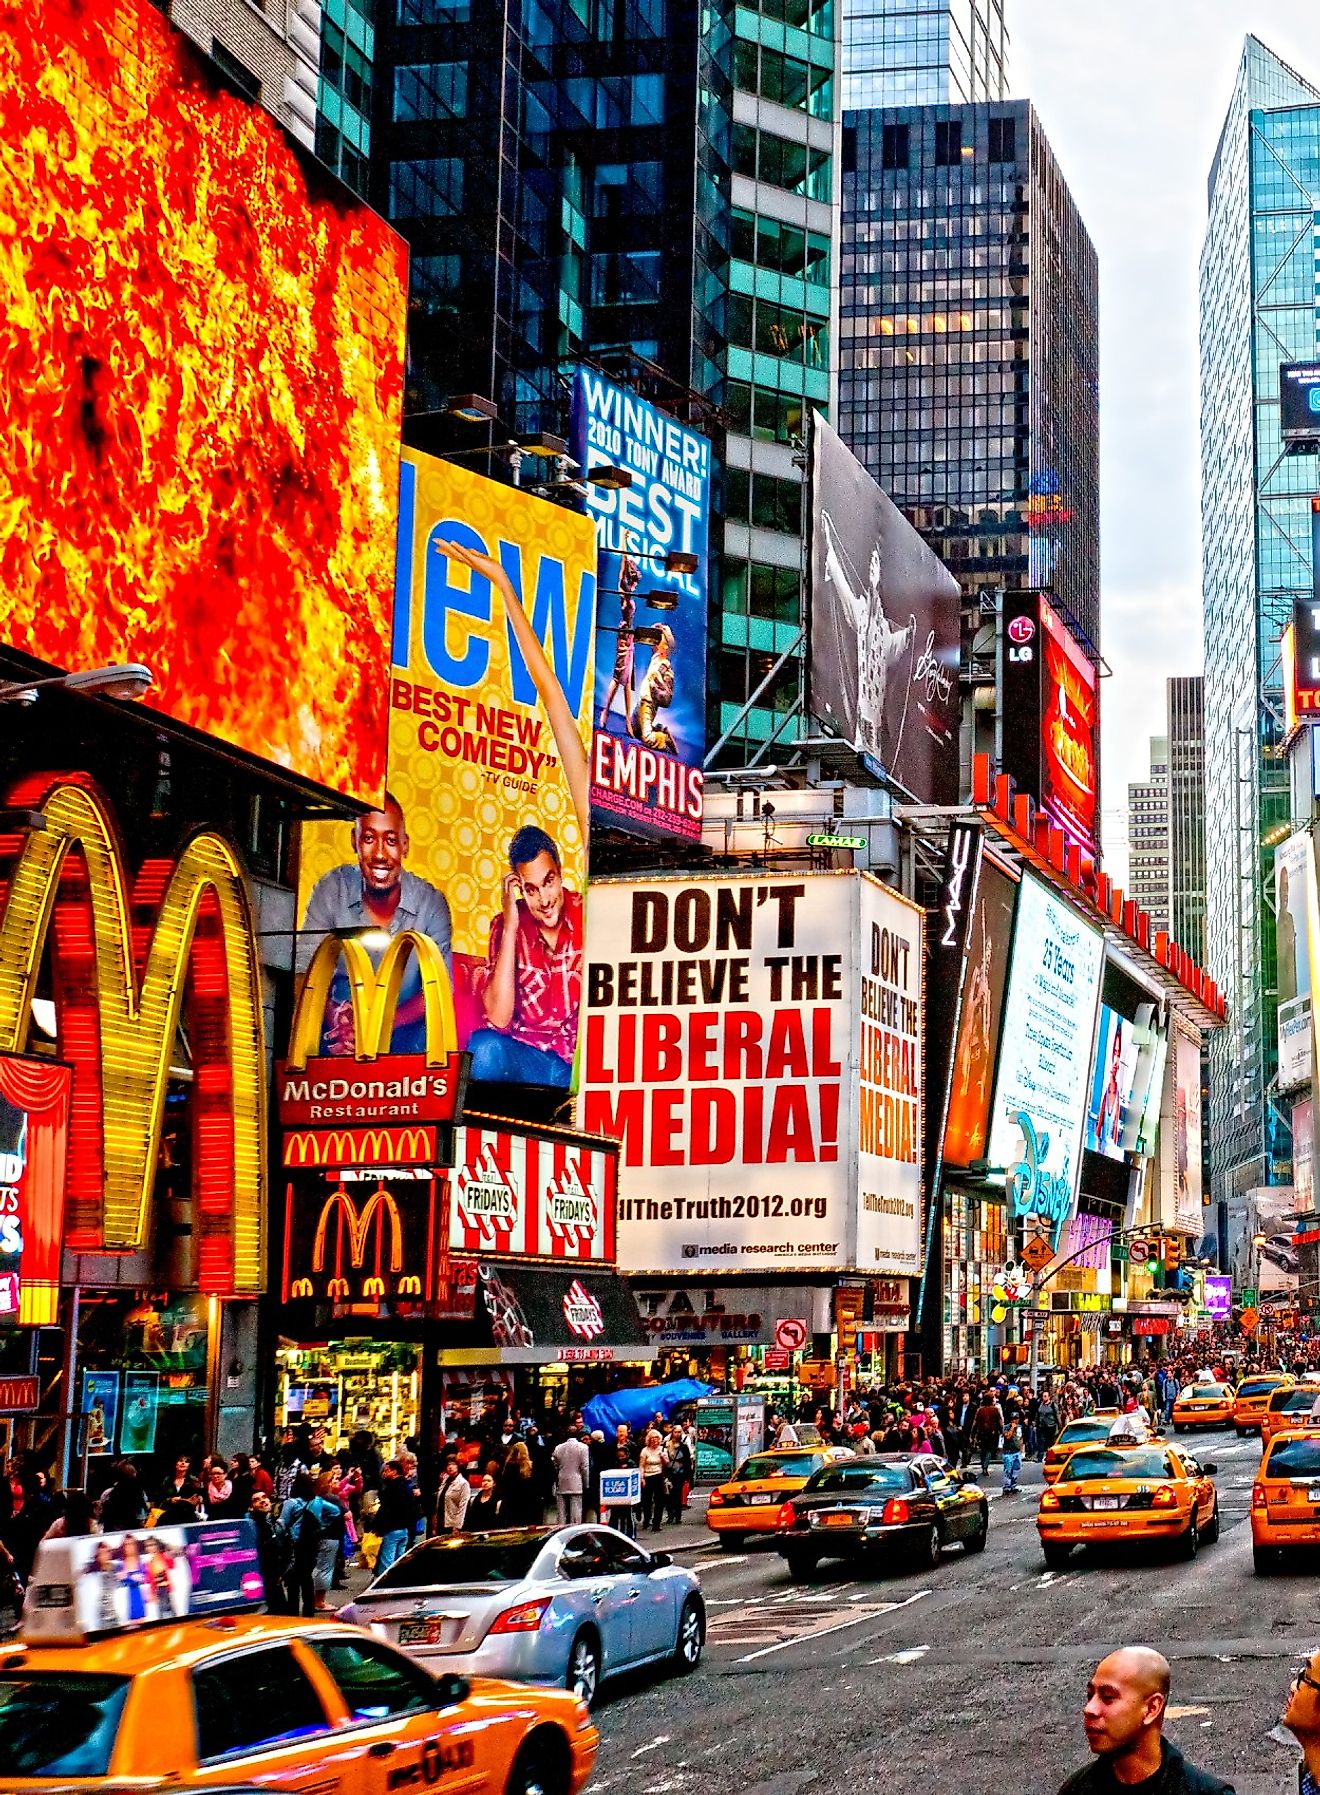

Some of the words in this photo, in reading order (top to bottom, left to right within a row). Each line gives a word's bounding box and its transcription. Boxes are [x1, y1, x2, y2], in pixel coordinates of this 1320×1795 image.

[583, 371, 707, 477] WINNER!
[588, 416, 621, 457] 2010
[626, 436, 658, 478] TONY
[662, 459, 700, 501] AWARD
[586, 445, 701, 554] BEST
[1009, 647, 1033, 661] LG
[391, 678, 467, 720] BEST
[475, 708, 542, 746] NEW
[503, 776, 538, 794] GUIDE
[813, 835, 860, 848] LAMAR
[629, 883, 806, 954] DON’T
[586, 957, 750, 1008] BELIEVE
[763, 954, 843, 1001] THE
[870, 920, 910, 992] DON'T
[860, 975, 898, 1032] BELIEVE
[899, 996, 918, 1038] THE
[585, 1008, 842, 1085] LIBERAL
[860, 1020, 918, 1099] LIBERAL
[283, 1076, 448, 1102] McDonald's
[309, 1102, 420, 1119] Restaurant
[581, 1083, 841, 1168] MEDIA!
[859, 1085, 918, 1165] MEDIA!
[700, 1243, 738, 1255] media
[741, 1242, 794, 1254] research
[797, 1241, 840, 1253] center
